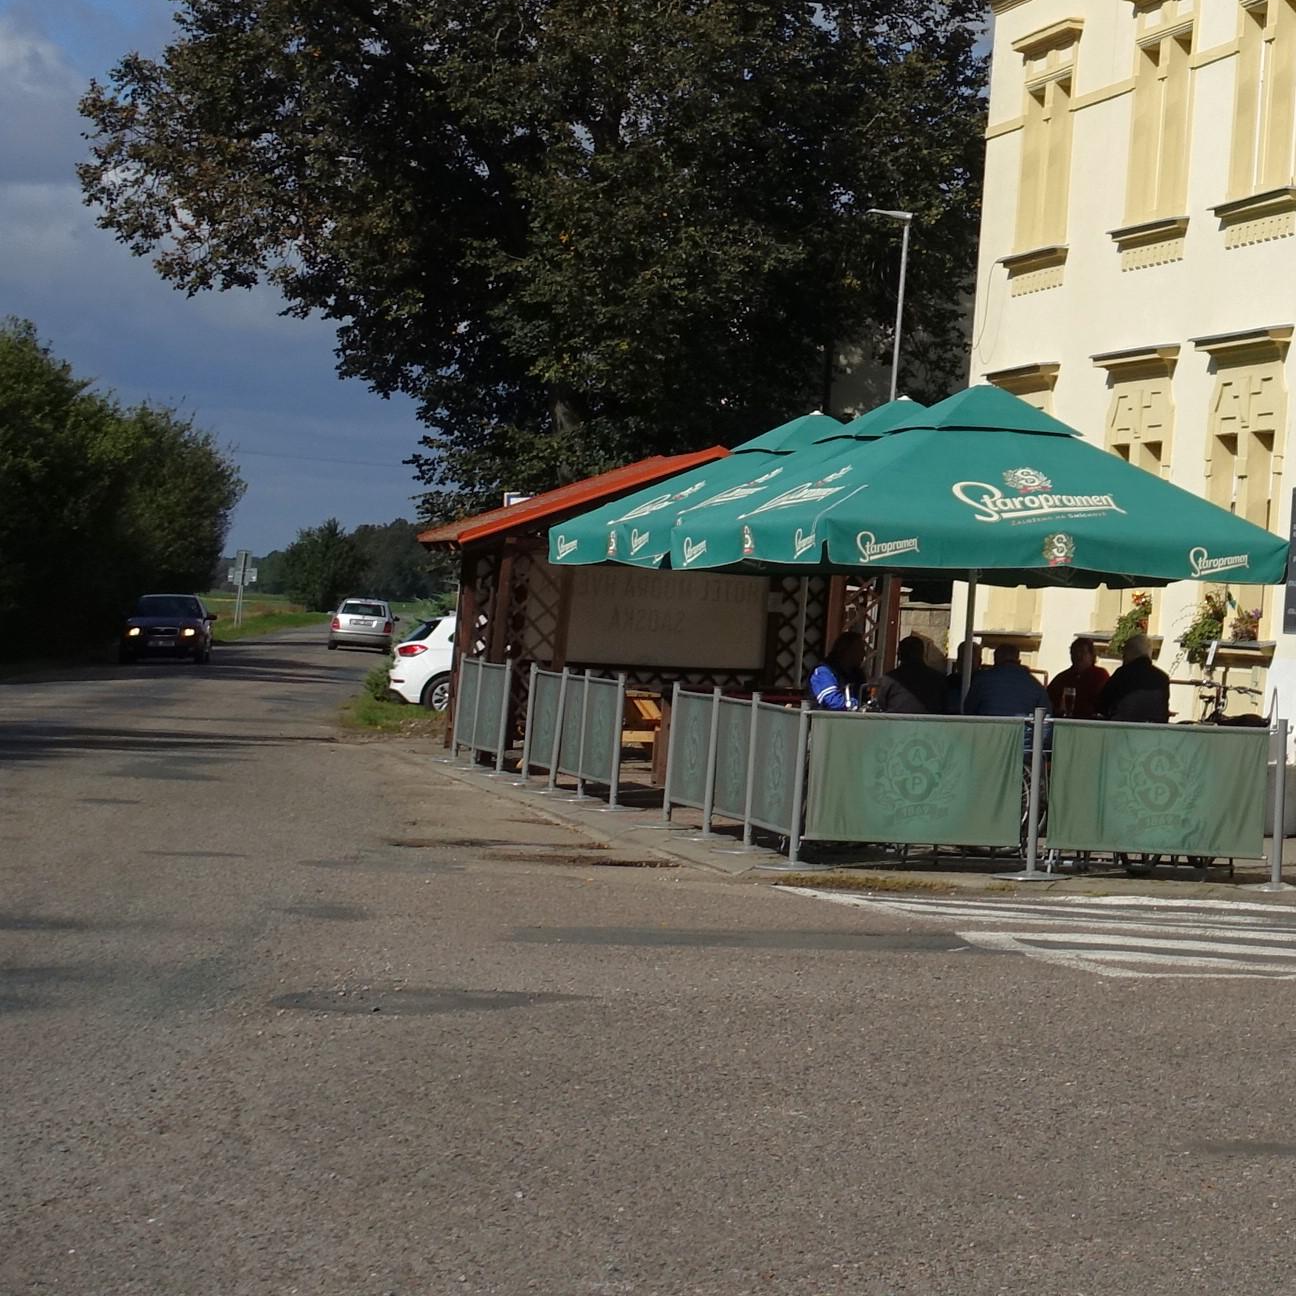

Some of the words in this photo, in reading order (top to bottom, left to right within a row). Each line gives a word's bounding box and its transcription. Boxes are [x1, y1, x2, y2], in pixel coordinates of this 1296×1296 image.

[952, 481, 1127, 523] Staropramen
[856, 530, 920, 563] Staropramen
[1190, 546, 1249, 578] Staropramen
